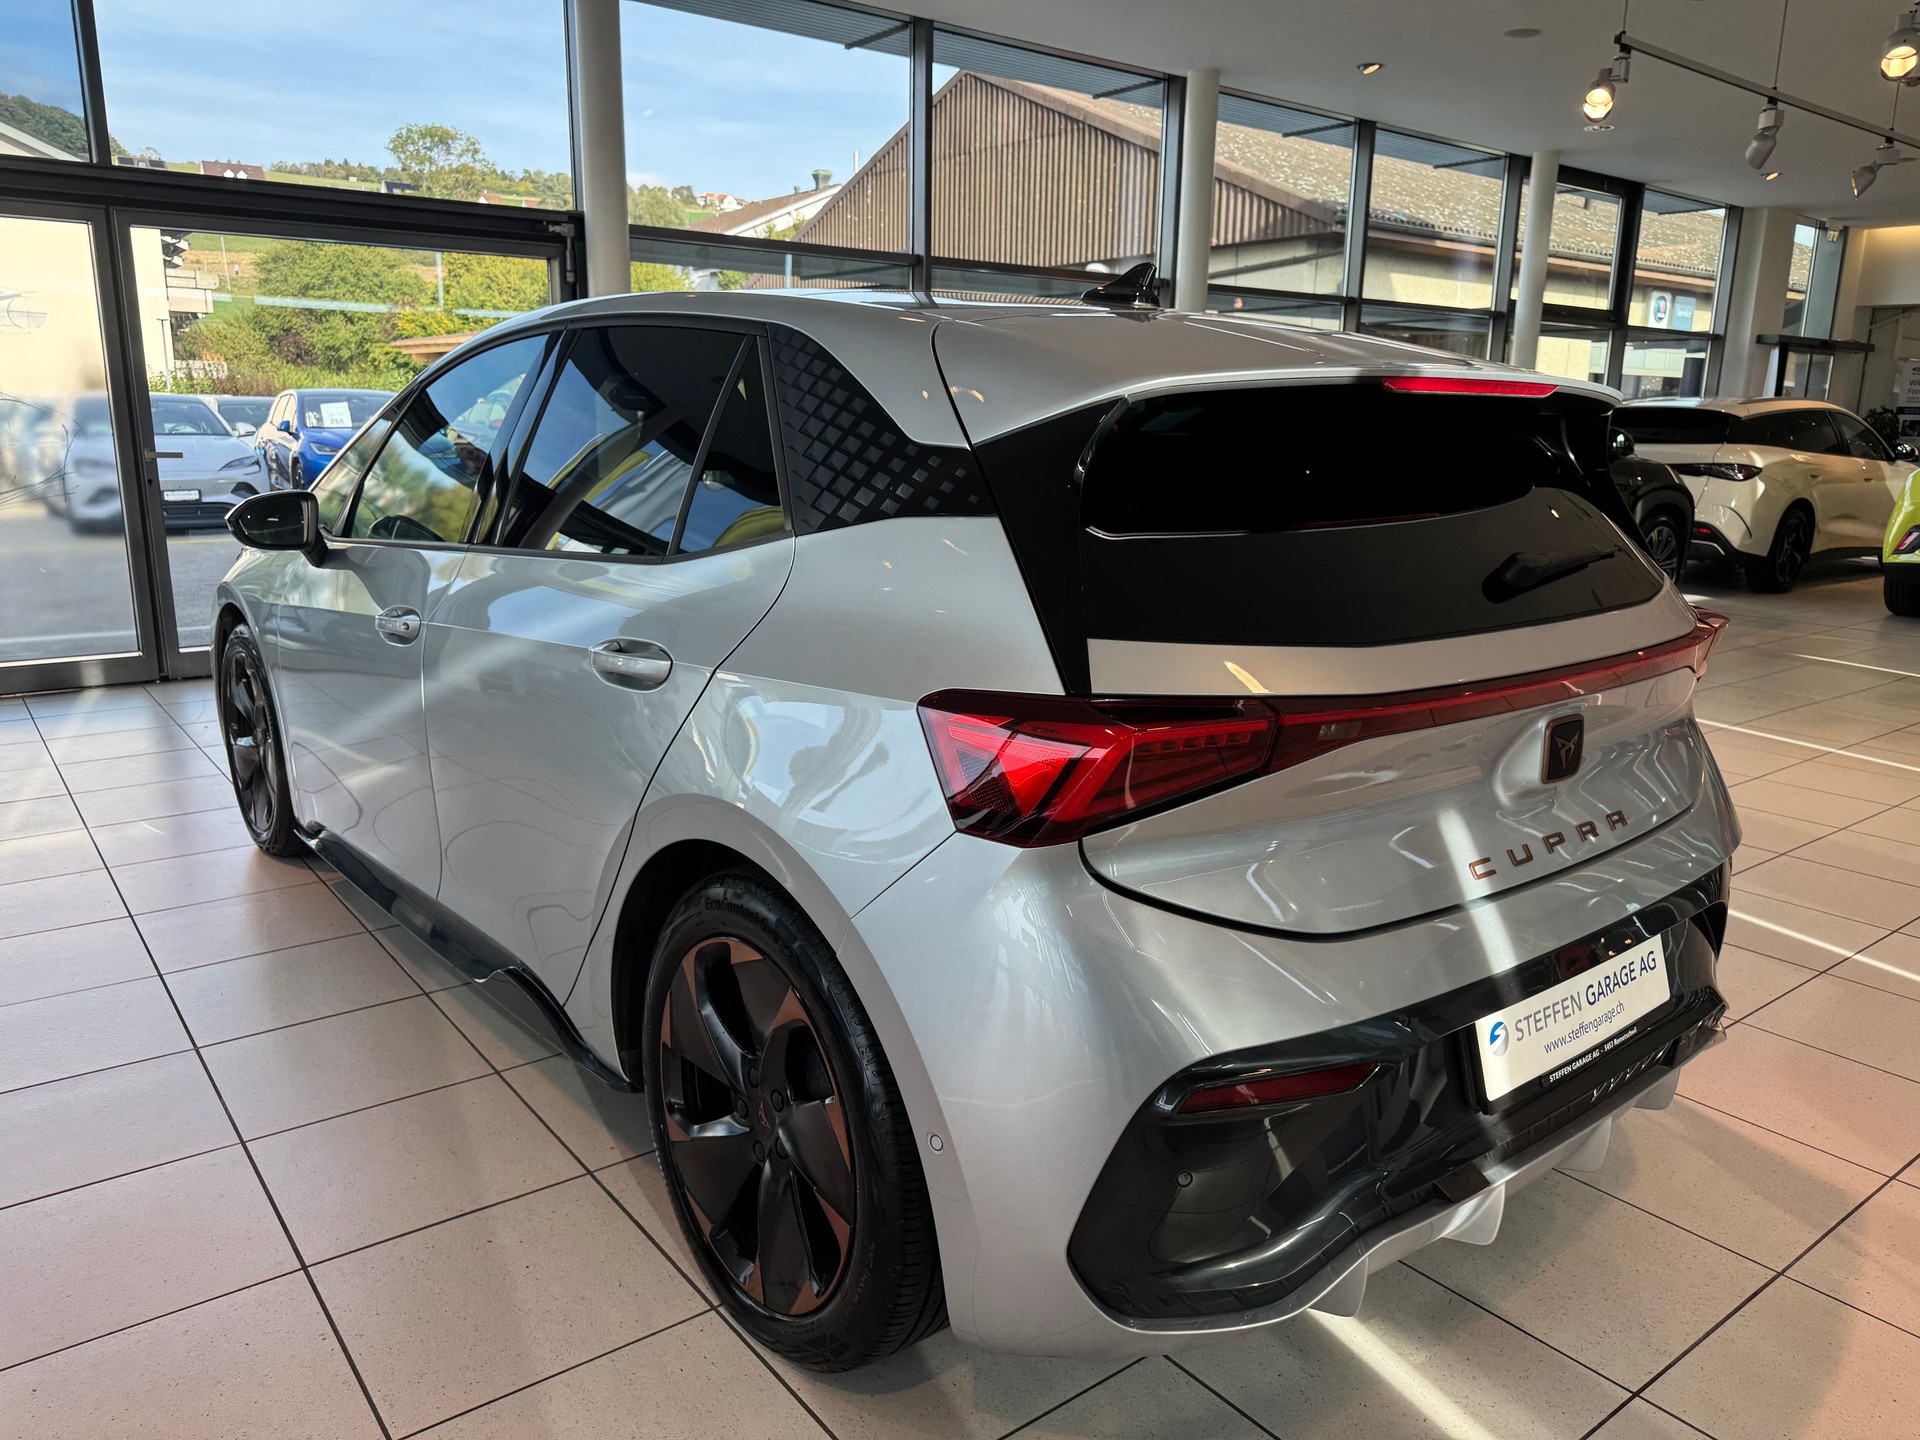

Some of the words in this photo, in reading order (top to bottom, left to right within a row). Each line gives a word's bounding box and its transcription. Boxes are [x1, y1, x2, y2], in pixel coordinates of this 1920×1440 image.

[1468, 810, 1628, 880] CUPRA
[705, 896, 760, 926] EcoContact
[1515, 991, 1584, 1042] STEFFEN
[1585, 960, 1637, 1006] GARAGE
[1639, 950, 1657, 977] AG
[1543, 1001, 1625, 1055] www.steffengarage.ch
[1549, 1065, 1572, 1082] STEFFEN
[1572, 1053, 1592, 1069] GARAGE
[1592, 1049, 1600, 1059] AG
